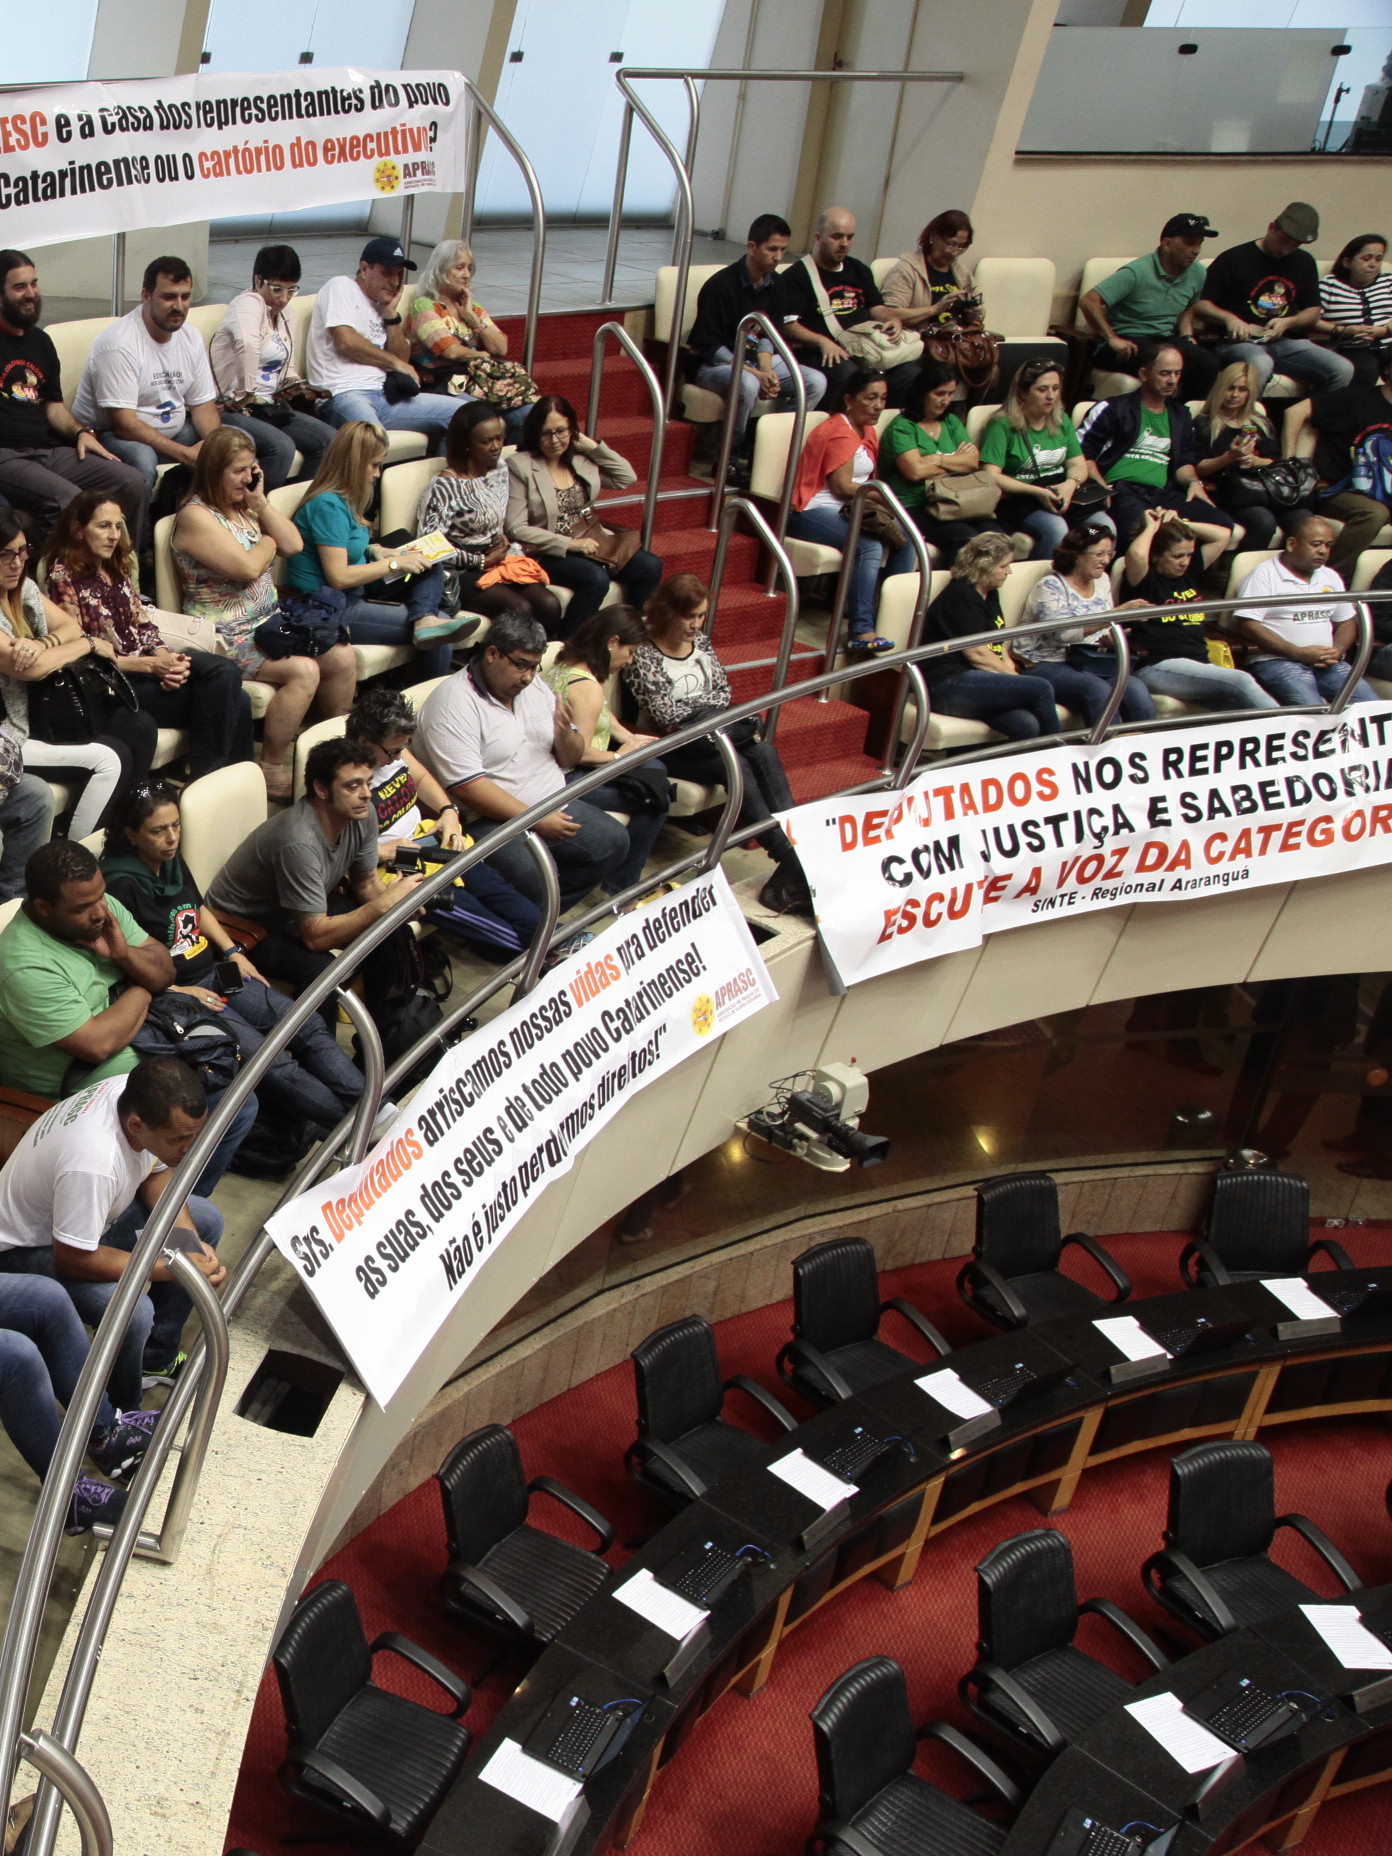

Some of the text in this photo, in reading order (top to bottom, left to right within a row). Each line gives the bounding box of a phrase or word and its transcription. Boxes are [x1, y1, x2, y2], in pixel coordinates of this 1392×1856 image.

[54, 112, 72, 144] e
[77, 110, 95, 140] a
[99, 104, 154, 136] casa
[154, 99, 193, 132] dos
[195, 85, 366, 131] representantes
[369, 79, 401, 111] do
[400, 81, 451, 109] povo
[154, 152, 180, 184] ou
[181, 152, 196, 181] o
[197, 138, 285, 180] cartório
[289, 135, 318, 170] do
[321, 120, 439, 164] executivo?
[1070, 751, 1150, 796] NOS
[881, 833, 965, 889] COM
[979, 803, 1136, 864] JUSTIÇA
[1146, 794, 1173, 829] E
[1012, 865, 1043, 900] A
[1056, 845, 1133, 891] VOZ
[1133, 838, 1192, 875] DA
[1030, 890, 1077, 914] SINTE
[1089, 878, 1166, 902] Regional
[1168, 864, 1251, 893] Araranguá
[714, 967, 757, 1011] APRASC
[290, 882, 718, 1279] Srs. Deputados arriscamos nossas vidas pra defender
[354, 940, 708, 1301] as suas, dos seus e de todo povo Catarinense!
[438, 1235, 475, 1293] Não
[471, 1211, 484, 1253] é
[481, 1177, 519, 1246] justo
